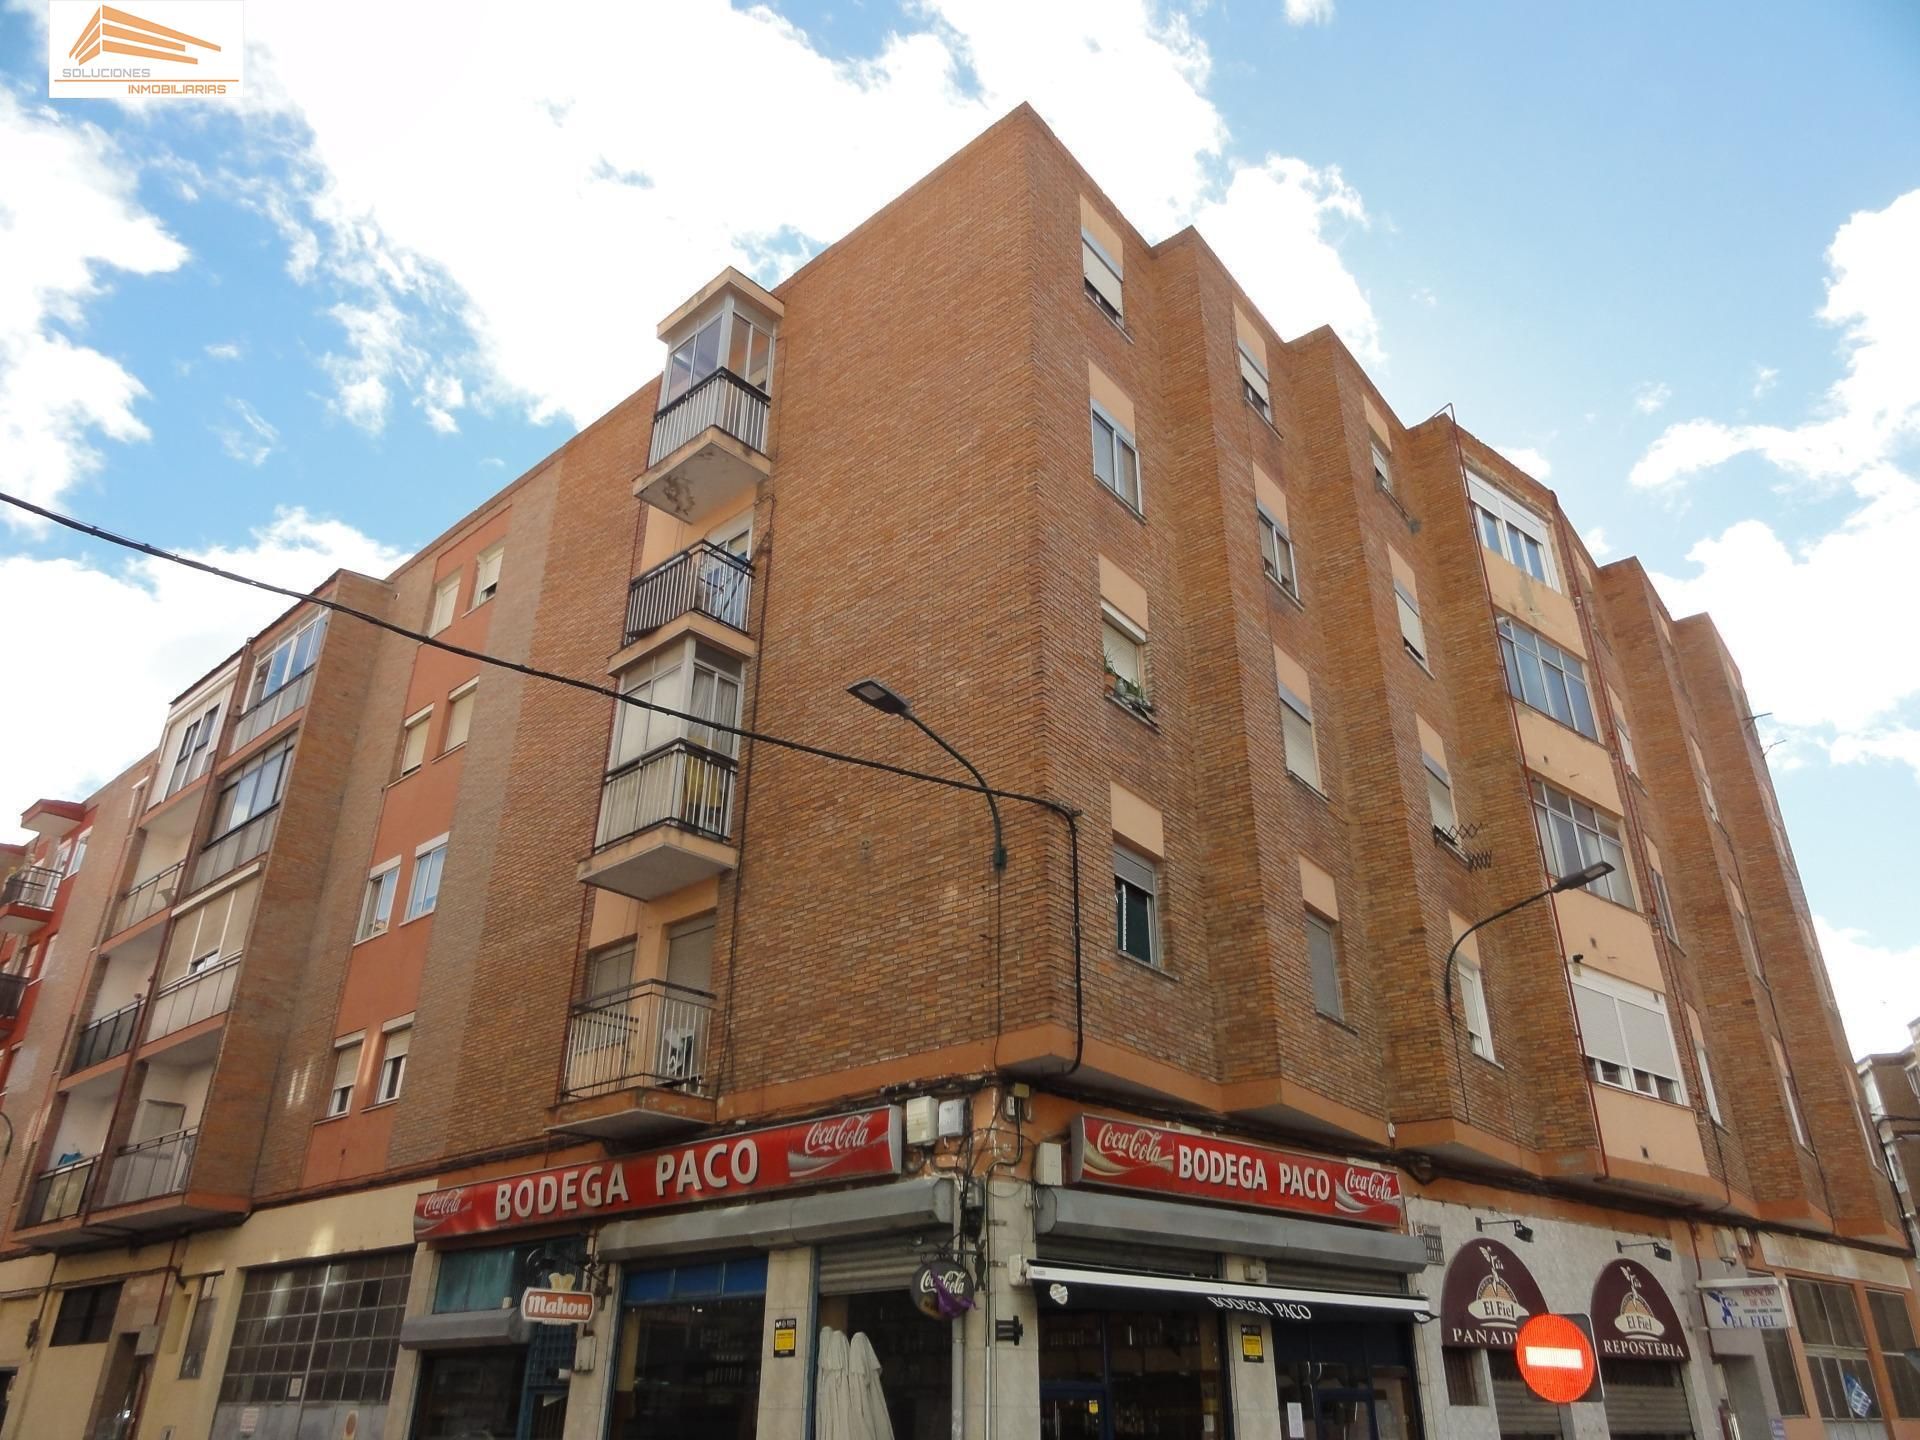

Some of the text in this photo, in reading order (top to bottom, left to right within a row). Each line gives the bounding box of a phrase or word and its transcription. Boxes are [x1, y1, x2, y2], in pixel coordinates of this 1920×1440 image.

[803, 1113, 873, 1155] Coca-Cola
[1096, 1122, 1163, 1162] Coca-Cola
[494, 1138, 758, 1222] BODEGA PACO
[1178, 1144, 1331, 1201] BODEGA PACO
[1344, 1166, 1393, 1201] Coca-Cola
[527, 1295, 590, 1316] Mahou
[1207, 1296, 1312, 1320] BODEGA PACO
[1483, 1301, 1515, 1318] El Fiel
[1626, 1315, 1653, 1331] El Fiel
[1452, 1327, 1518, 1345] PANAD
[1602, 1339, 1685, 1358] REPOSTERIA
